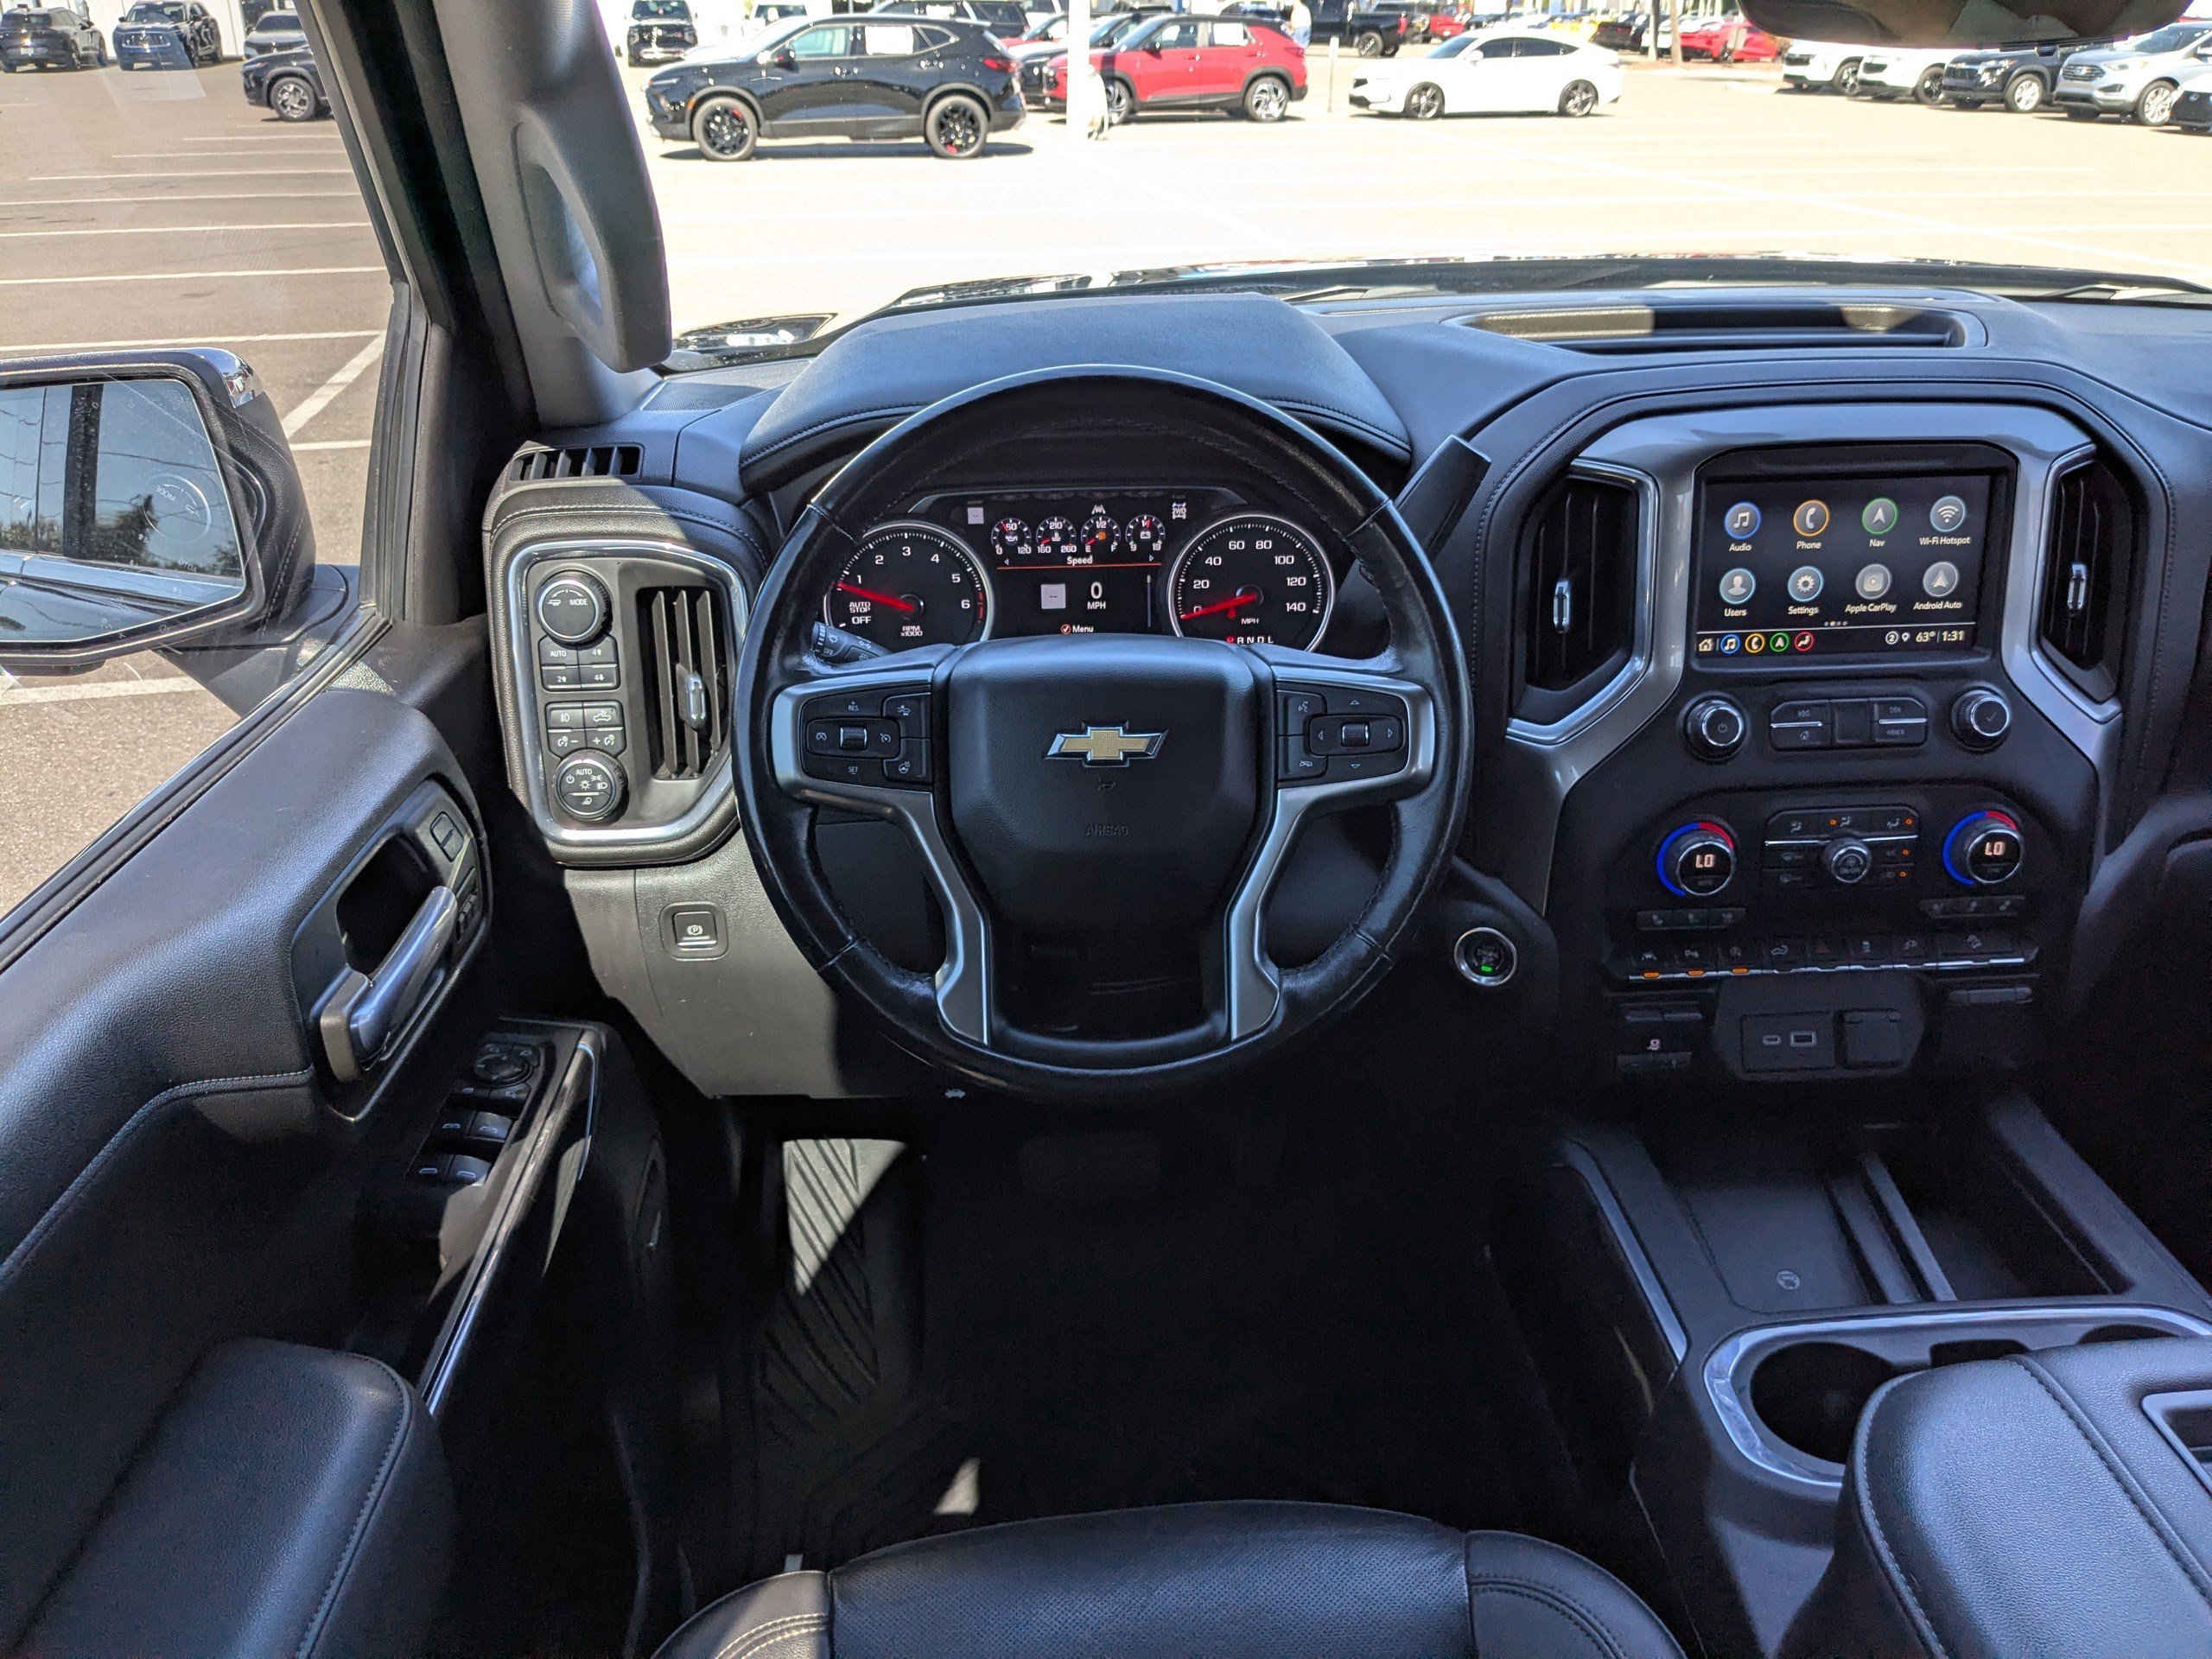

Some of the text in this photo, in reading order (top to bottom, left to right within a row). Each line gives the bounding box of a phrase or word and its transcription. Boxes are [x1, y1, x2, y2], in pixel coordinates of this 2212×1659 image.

[1049, 521, 1063, 530] 210
[1228, 540, 1245, 550] 60
[1255, 540, 1272, 550] 80
[1796, 541, 1821, 550] Phone
[1919, 536, 1971, 546] Wi-Fi Hotspot
[902, 546, 912, 556] 3
[1085, 544, 1091, 553] E
[1110, 543, 1116, 552] F
[1728, 543, 1752, 551] Audio
[875, 555, 884, 565] 2
[931, 553, 940, 563] 4
[1066, 555, 1093, 566] Speed
[1205, 556, 1222, 566] 40
[1274, 556, 1294, 565] 100
[856, 575, 862, 584] 1
[951, 573, 961, 583] 5
[1286, 576, 1306, 587] 120
[1193, 579, 1210, 589] 20
[1090, 581, 1103, 599] 0
[961, 600, 970, 609] 6
[1286, 602, 1306, 612] 140
[1846, 603, 1897, 613] Apple CarPlay
[1913, 601, 1943, 610] Android
[1724, 608, 1747, 617] Users
[1788, 606, 1819, 616] Settings
[1942, 630, 1965, 641] 1:31
[823, 647, 835, 657] OFF
[1985, 841, 2005, 855] LO
[1695, 854, 1715, 868] LO
